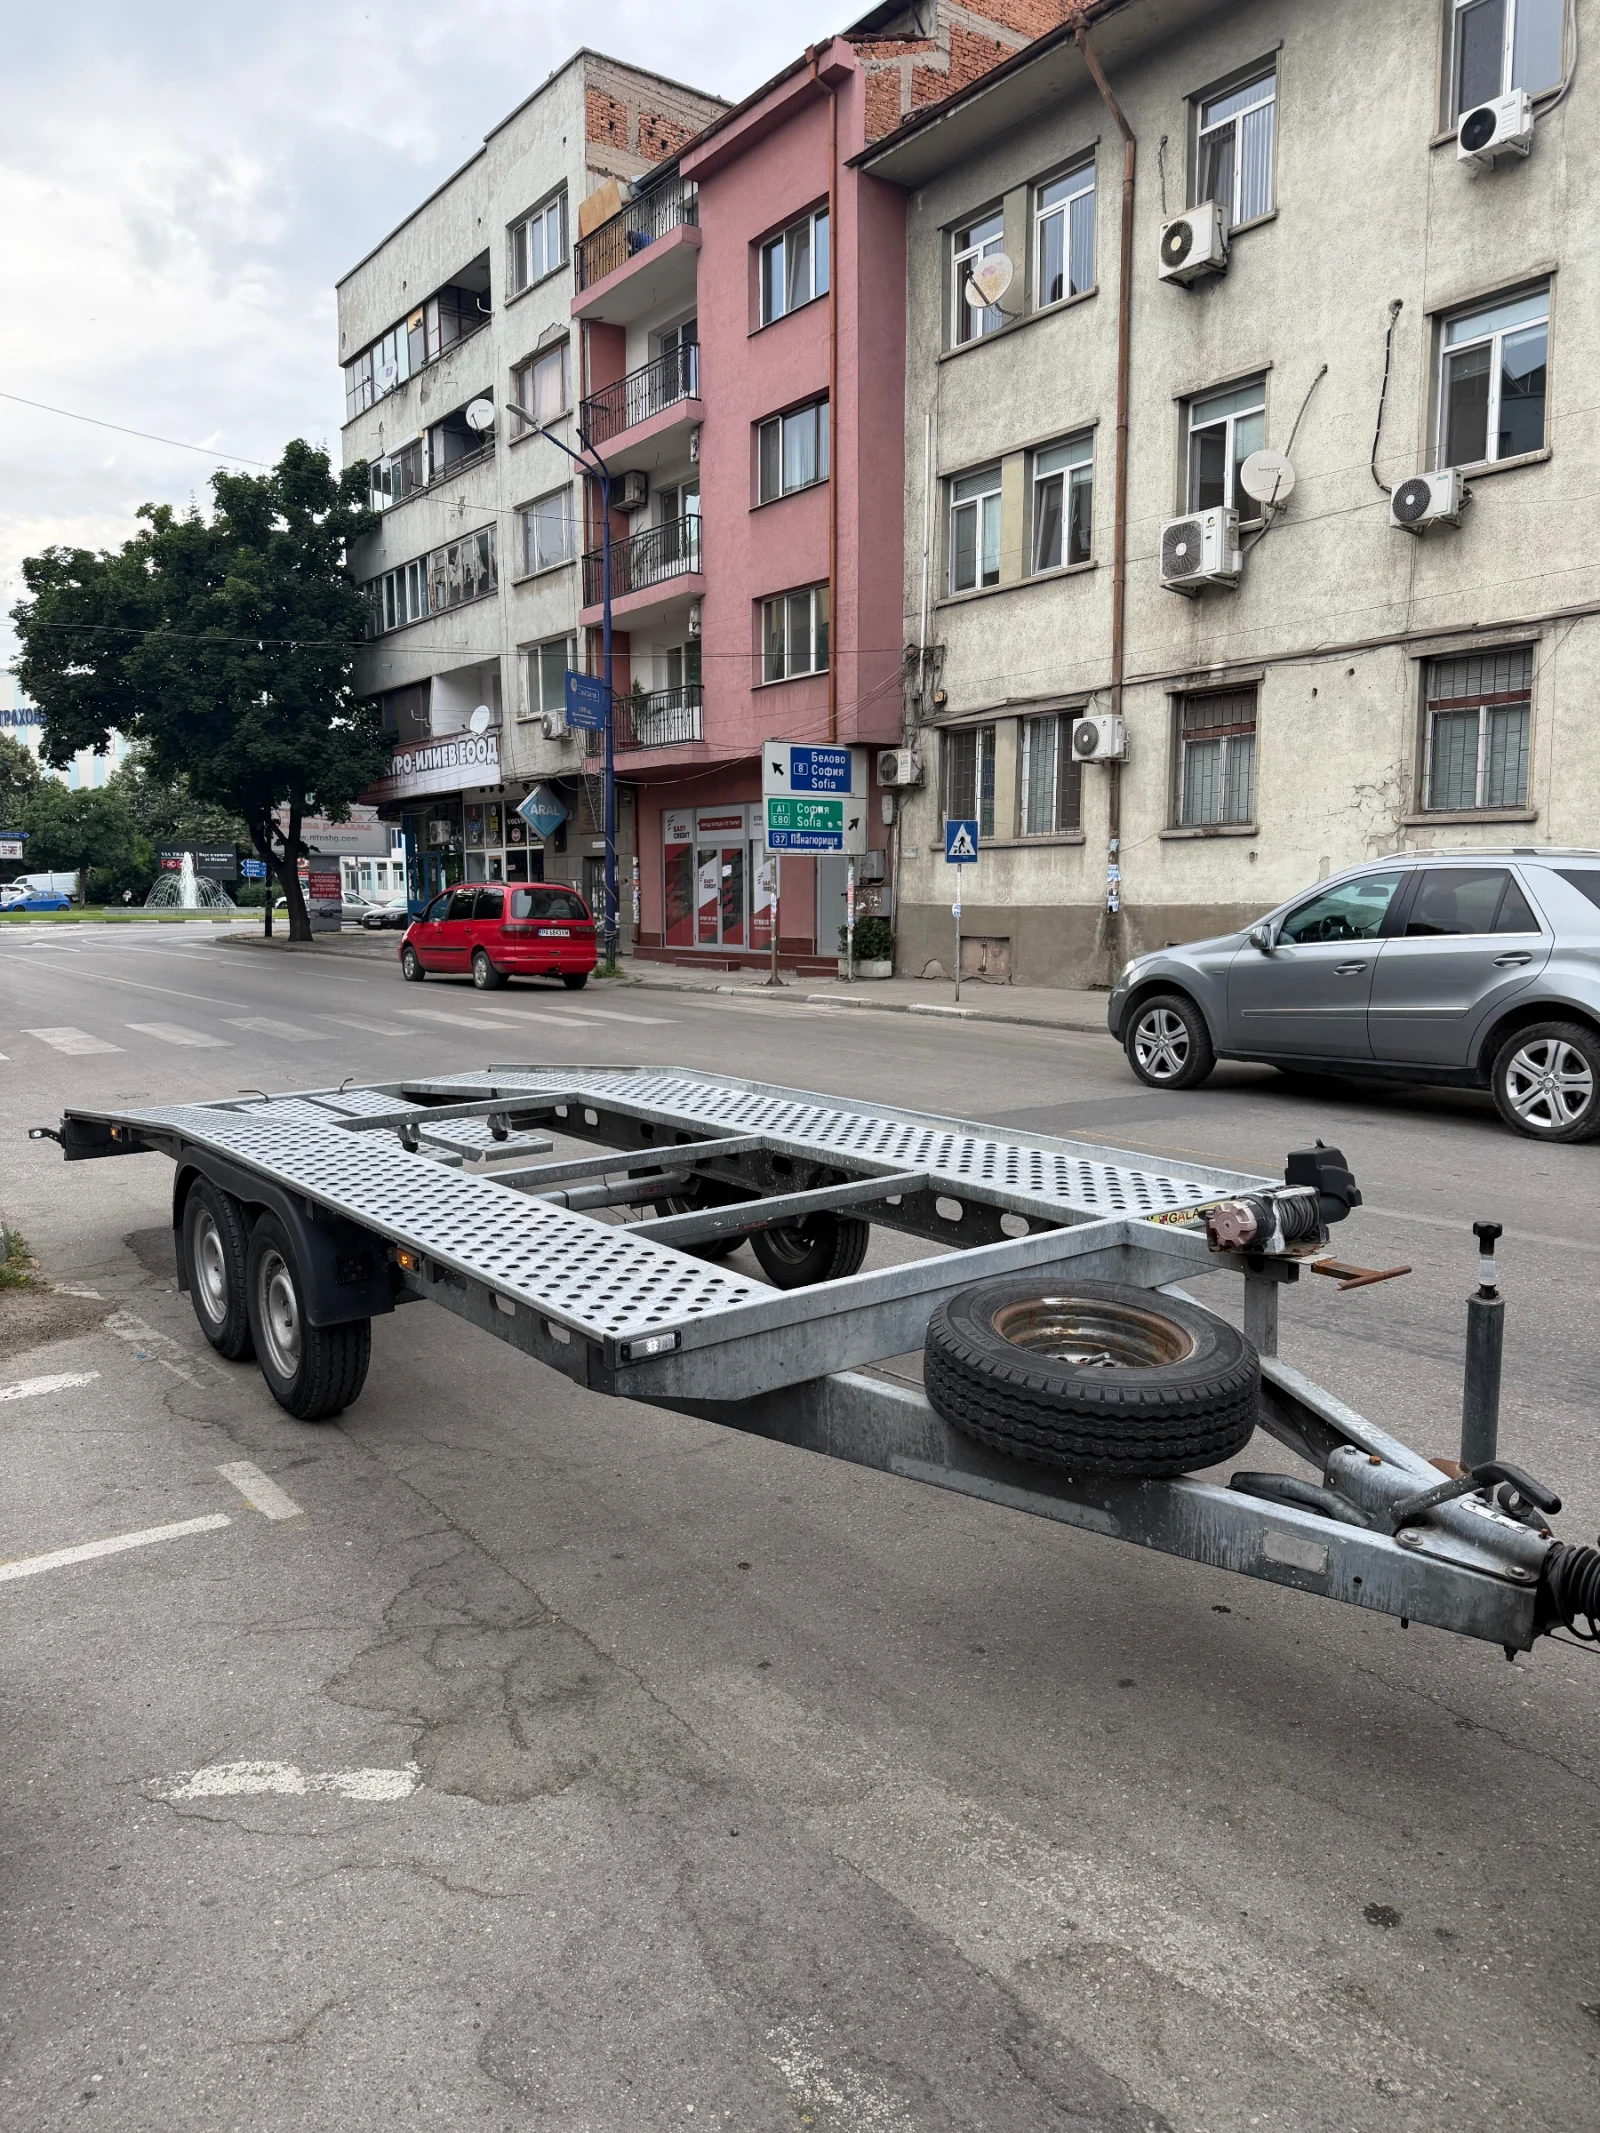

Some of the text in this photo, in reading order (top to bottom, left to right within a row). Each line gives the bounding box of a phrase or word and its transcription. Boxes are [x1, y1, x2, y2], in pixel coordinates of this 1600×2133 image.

[458, 735, 499, 766] ЕООД
[811, 751, 845, 764] Белово
[798, 764, 844, 777] 8 София
[811, 778, 836, 789] Sofia
[530, 804, 560, 815] ARAL
[776, 804, 785, 813] A1
[772, 815, 789, 824] E80
[797, 816, 822, 828] Sofia
[774, 834, 786, 844] 37
[790, 833, 838, 847] Панагюрище
